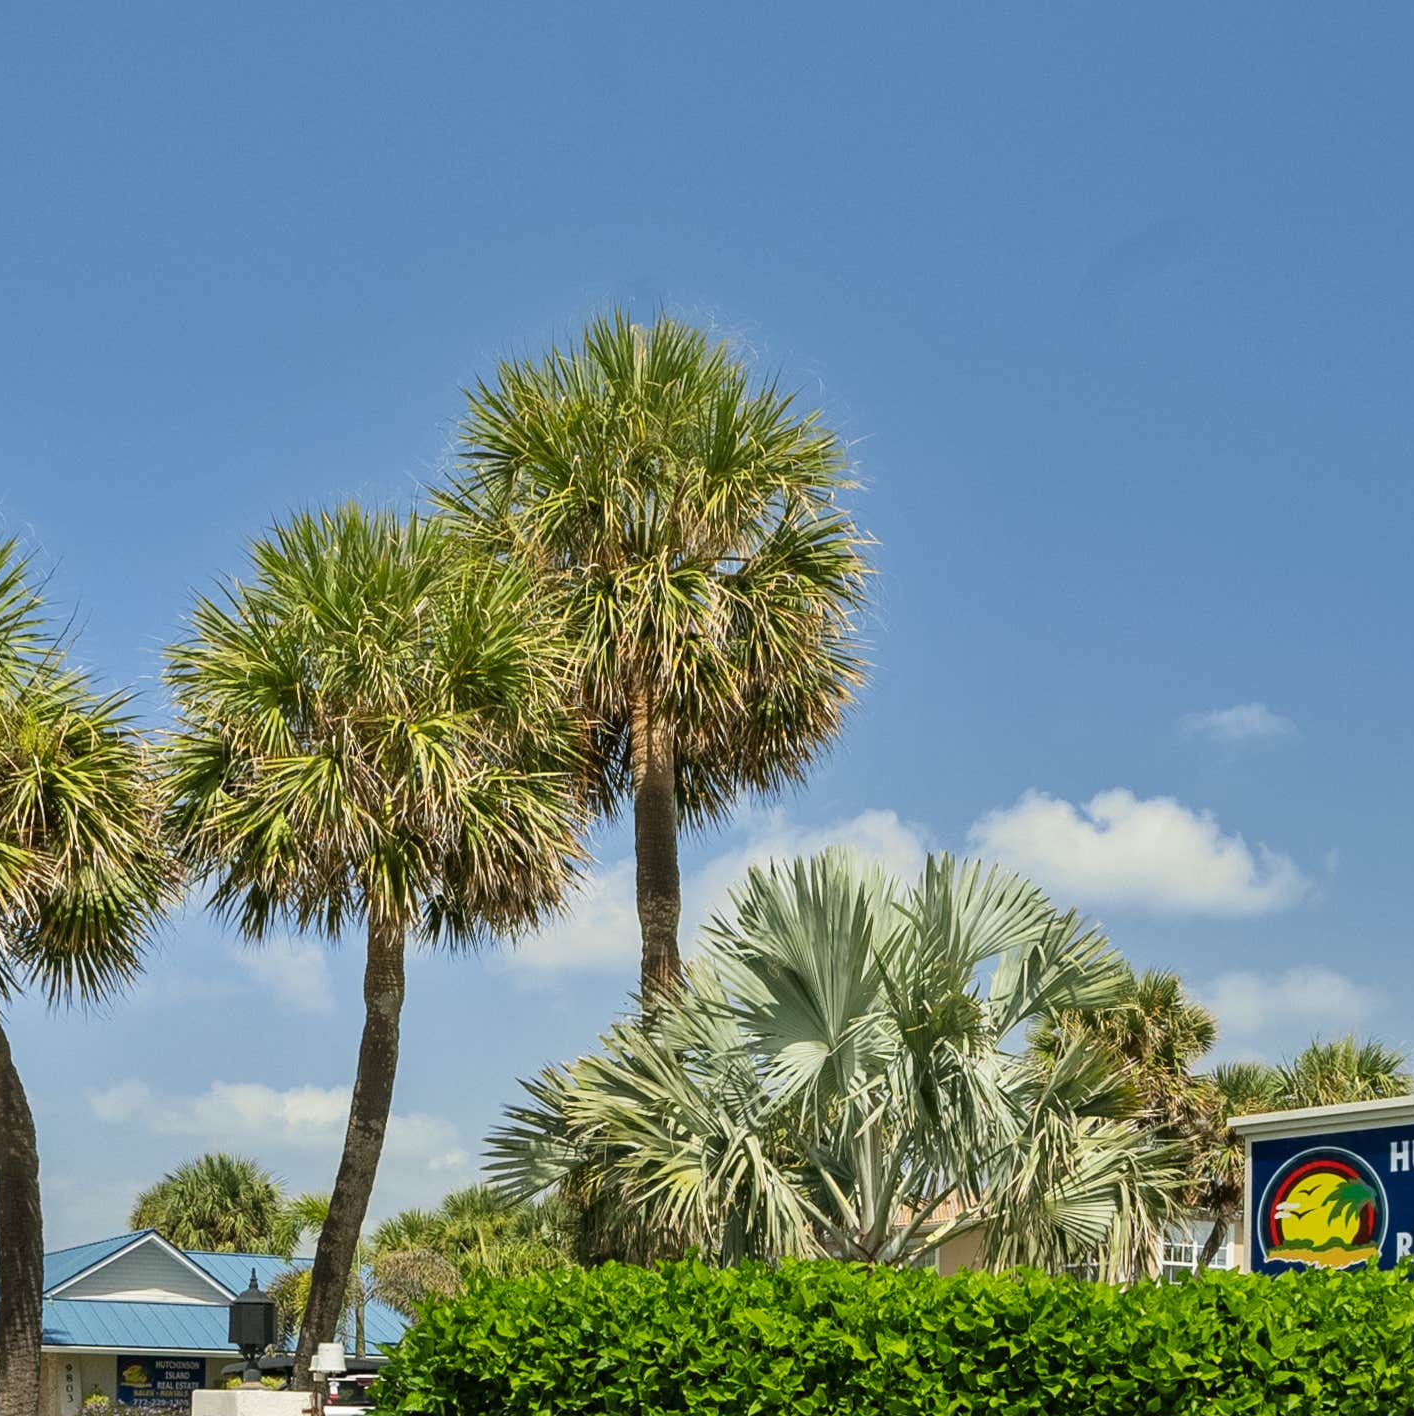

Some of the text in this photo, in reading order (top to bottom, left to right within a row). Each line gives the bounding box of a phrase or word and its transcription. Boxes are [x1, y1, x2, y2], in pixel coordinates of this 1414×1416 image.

[155, 1361, 200, 1369] HUTCHINSON
[165, 1371, 191, 1380] ISLAND
[157, 1382, 174, 1390] REAL
